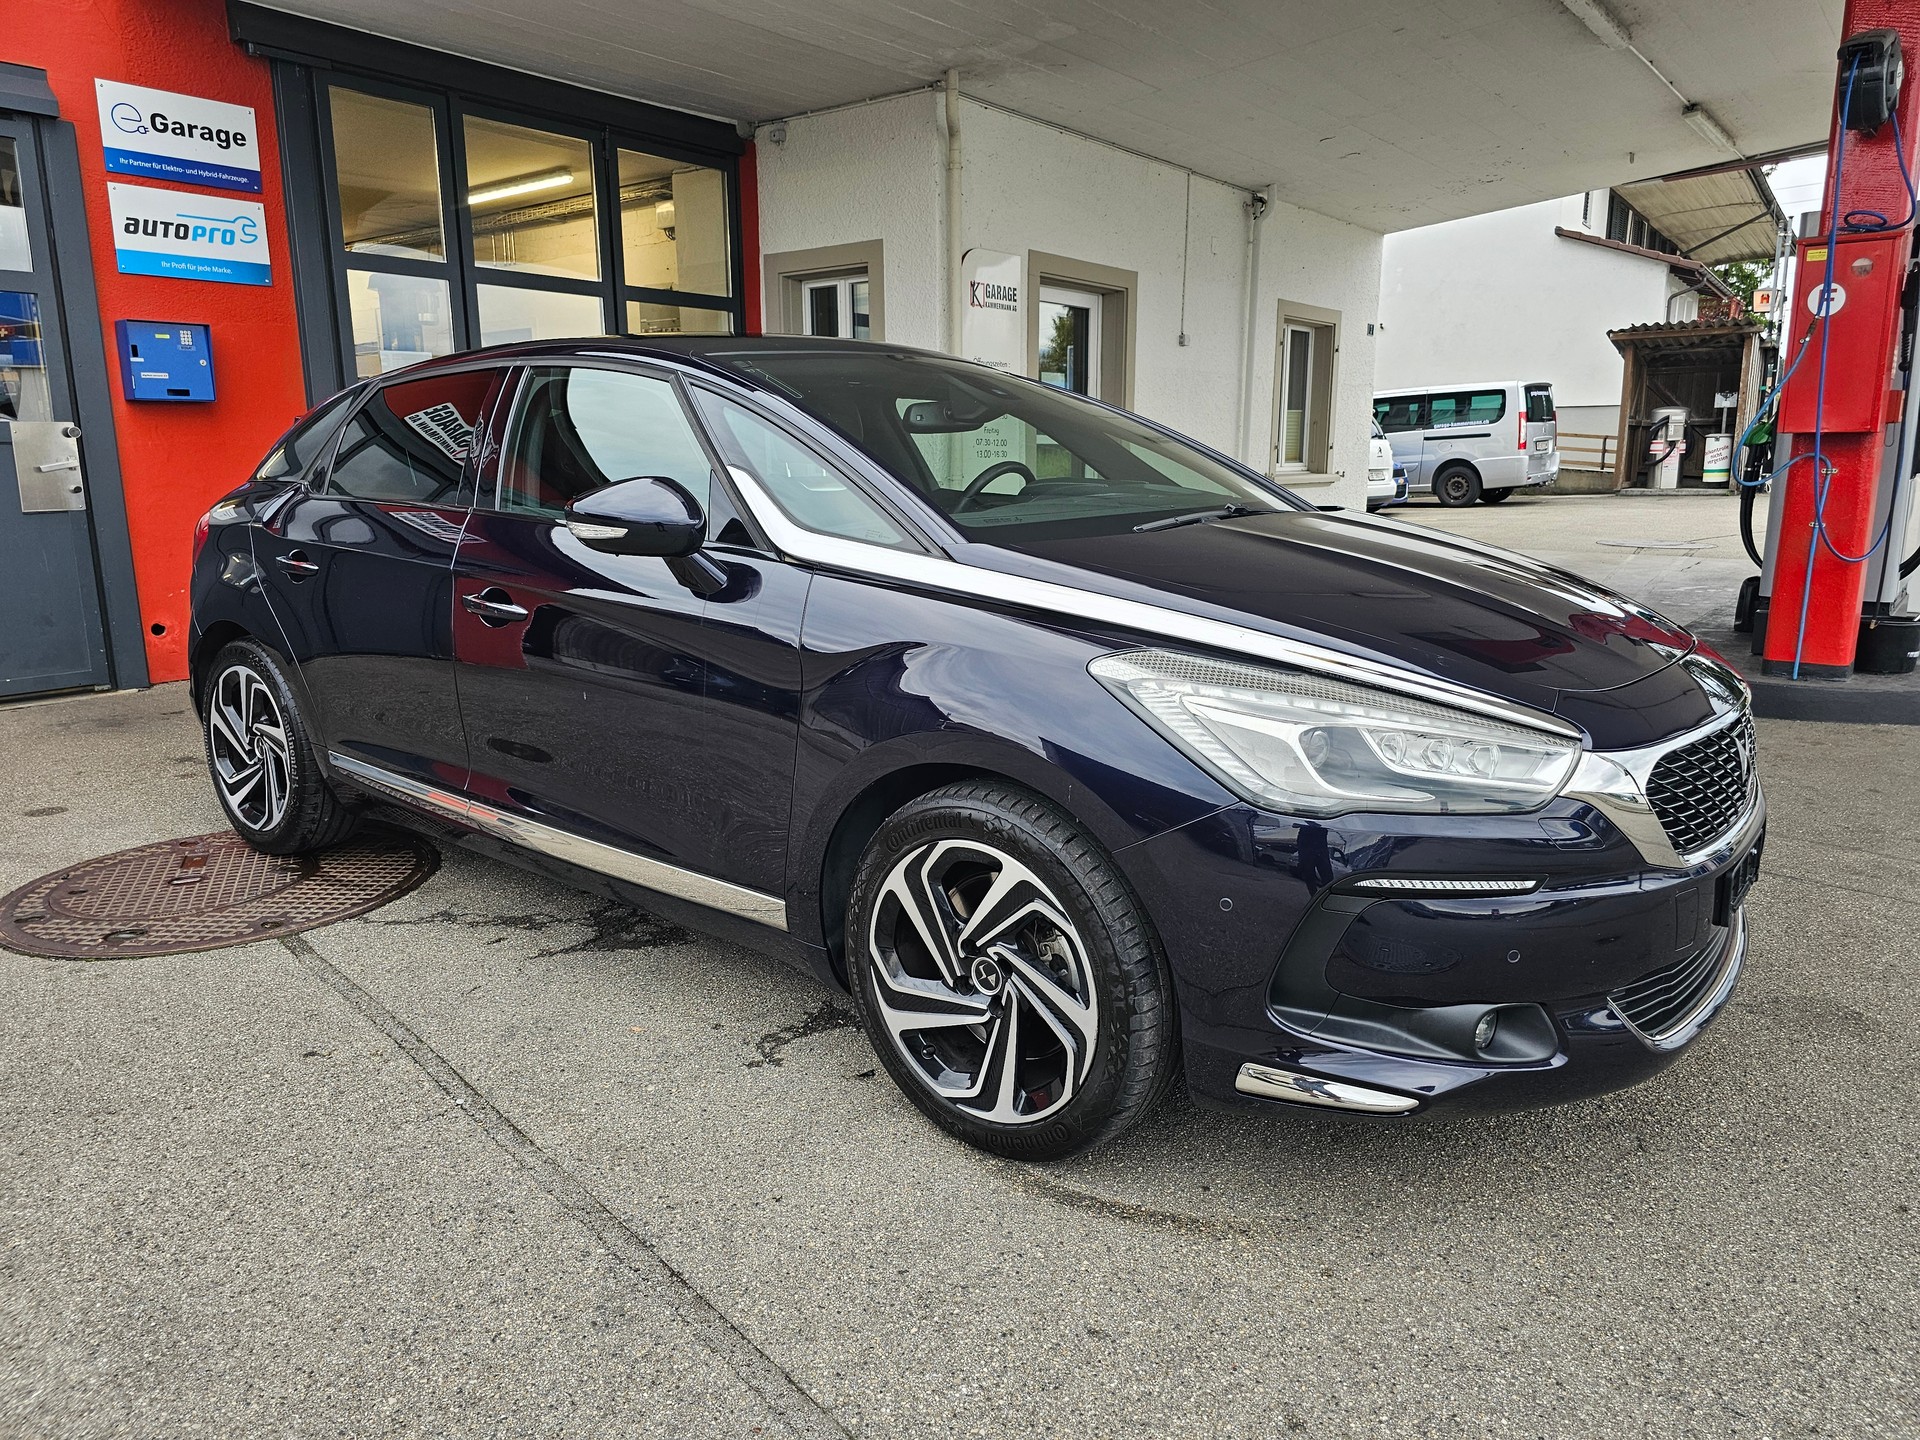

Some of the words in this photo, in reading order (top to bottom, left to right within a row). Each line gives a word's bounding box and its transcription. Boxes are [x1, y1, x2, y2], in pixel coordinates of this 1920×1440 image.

[119, 157, 128, 165] Ihr
[129, 158, 151, 168] Partner
[152, 162, 161, 170] für
[162, 164, 185, 173] Elektro-
[185, 167, 198, 176] und
[198, 169, 250, 184] Hybrid-Fahrzeuge.
[171, 261, 186, 270] Profi
[187, 263, 197, 271] für
[197, 264, 211, 274] jede
[212, 266, 233, 275] Marke.
[985, 283, 1018, 303] GARAGE
[985, 301, 1011, 312] KAMMERMANN
[1012, 305, 1018, 313] AG
[983, 426, 1000, 436] Freitag
[886, 811, 963, 853] Continental
